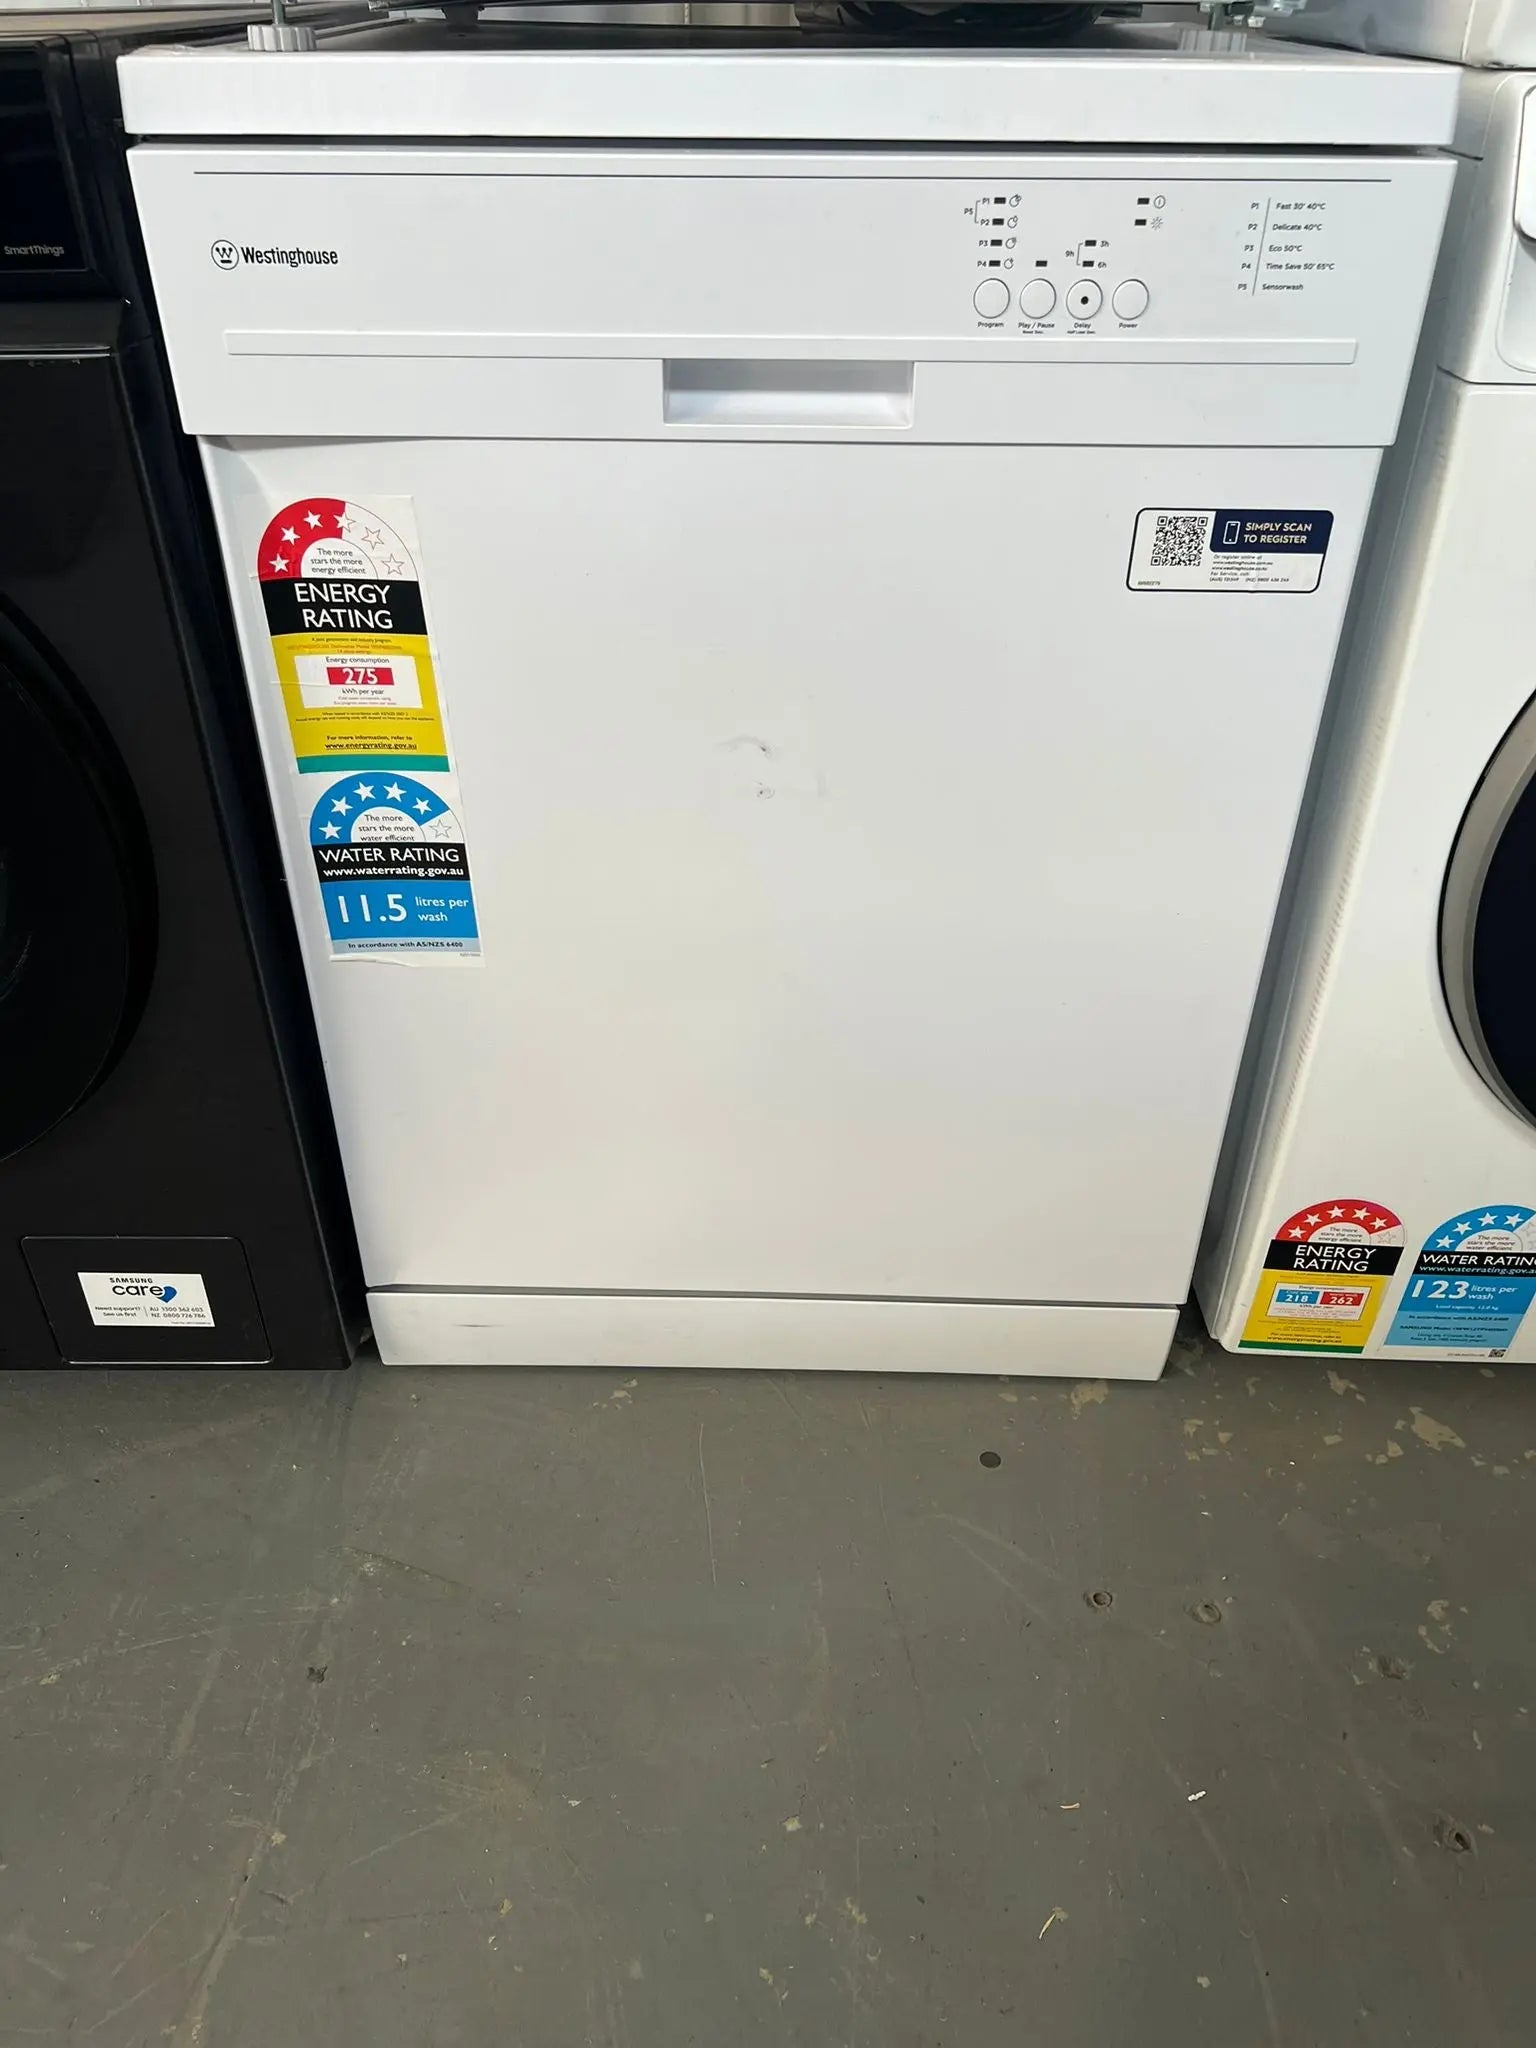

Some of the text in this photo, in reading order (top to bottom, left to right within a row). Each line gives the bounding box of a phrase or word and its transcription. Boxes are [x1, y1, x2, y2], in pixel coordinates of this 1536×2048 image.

[1100, 240, 1109, 248] 3h
[4, 245, 65, 256] SmartThings
[241, 246, 338, 268] Westinghouse
[1098, 261, 1107, 269] 6h
[977, 321, 1004, 329] Program
[1245, 522, 1312, 532] SIMPLY SCAN
[1244, 534, 1307, 544] TO REGISTER
[317, 548, 332, 556] The
[312, 566, 366, 575] energy efficient
[294, 583, 390, 604] ENERGY
[302, 609, 393, 629] RATING
[342, 667, 378, 685] 275
[319, 848, 460, 862] WATER RATING
[323, 866, 464, 877] www.waterrating.gov.au
[338, 893, 408, 923] 11.5
[415, 897, 469, 909] litres per
[417, 912, 448, 922] wash
[1295, 1244, 1377, 1260] ENERGY
[1293, 1258, 1369, 1272] RATING
[1422, 1254, 1478, 1265] WATER
[112, 1285, 164, 1296] care
[1411, 1280, 1470, 1300] 123
[1471, 1285, 1496, 1293] litres
[1284, 1294, 1309, 1303] 218
[1329, 1296, 1354, 1305] 262
